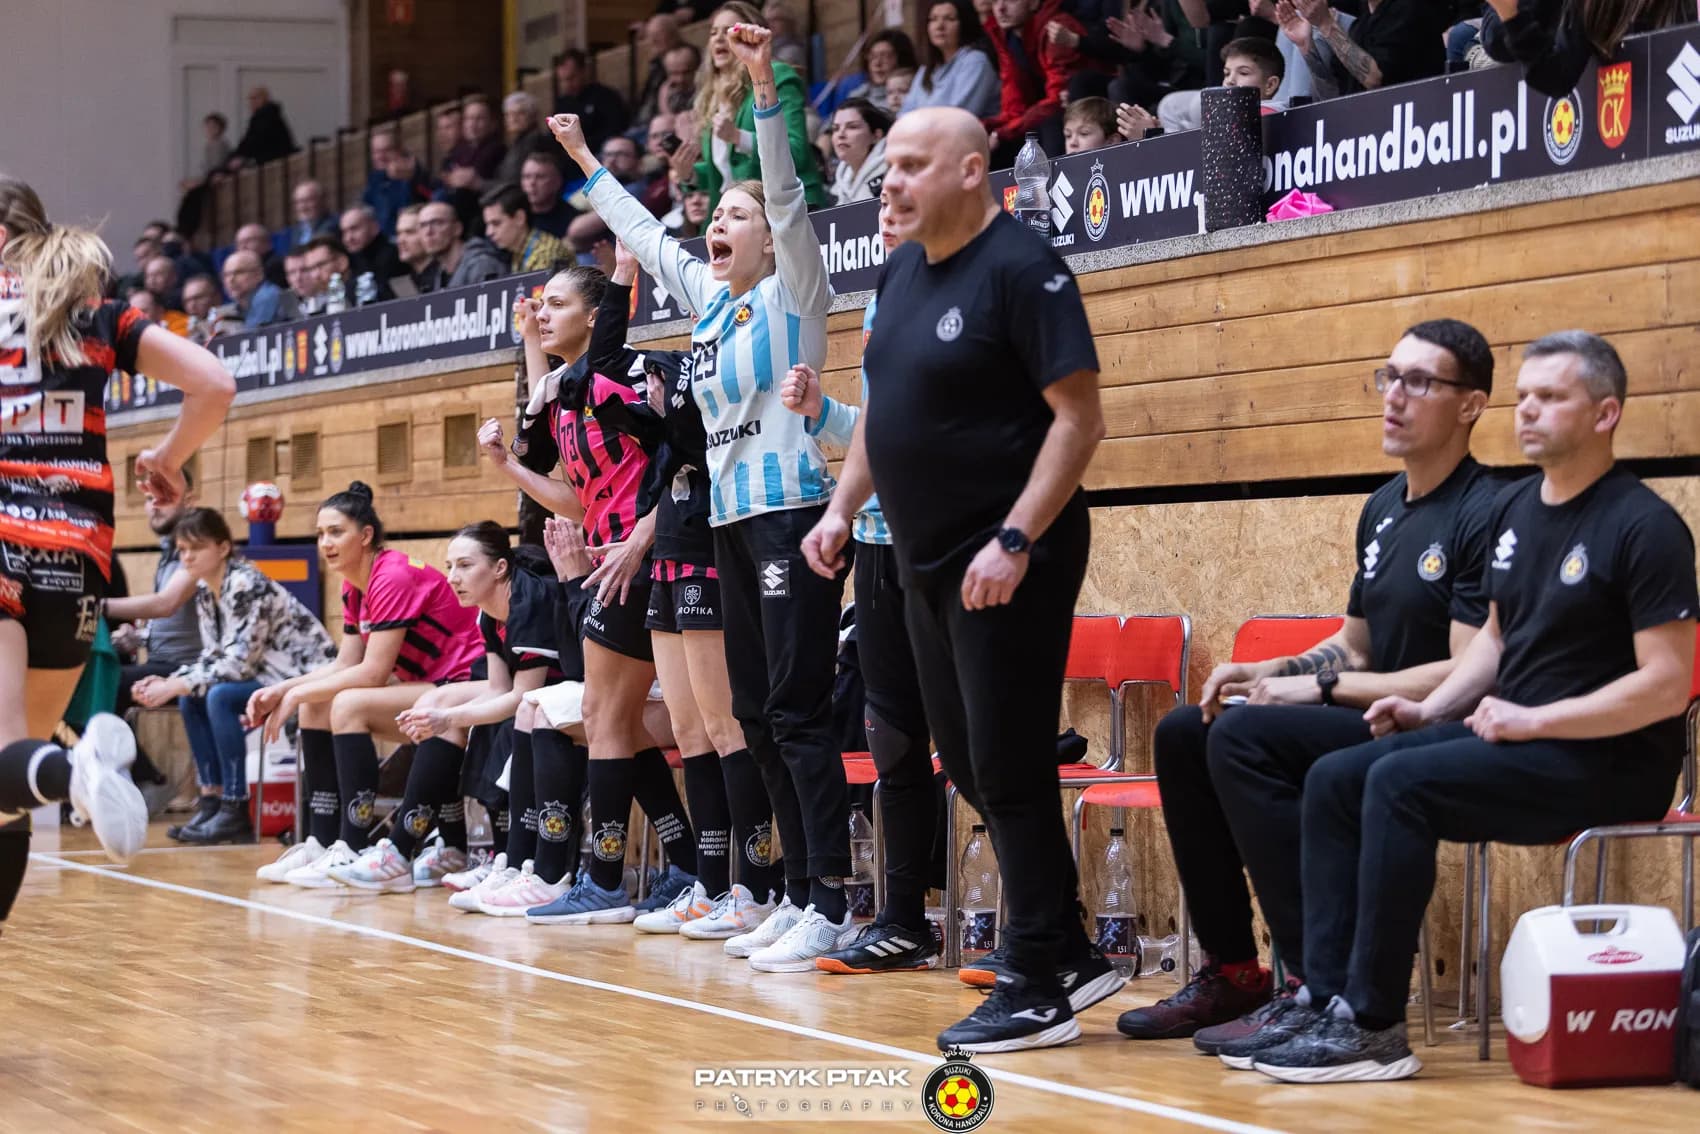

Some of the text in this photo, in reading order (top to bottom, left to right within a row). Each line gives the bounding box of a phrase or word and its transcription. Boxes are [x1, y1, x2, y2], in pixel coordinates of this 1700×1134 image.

[1601, 97, 1625, 139] CK
[1052, 233, 1075, 248] UZUKI
[345, 290, 508, 359] www.koronahandball.pl
[1566, 1008, 1678, 1033] W RON
